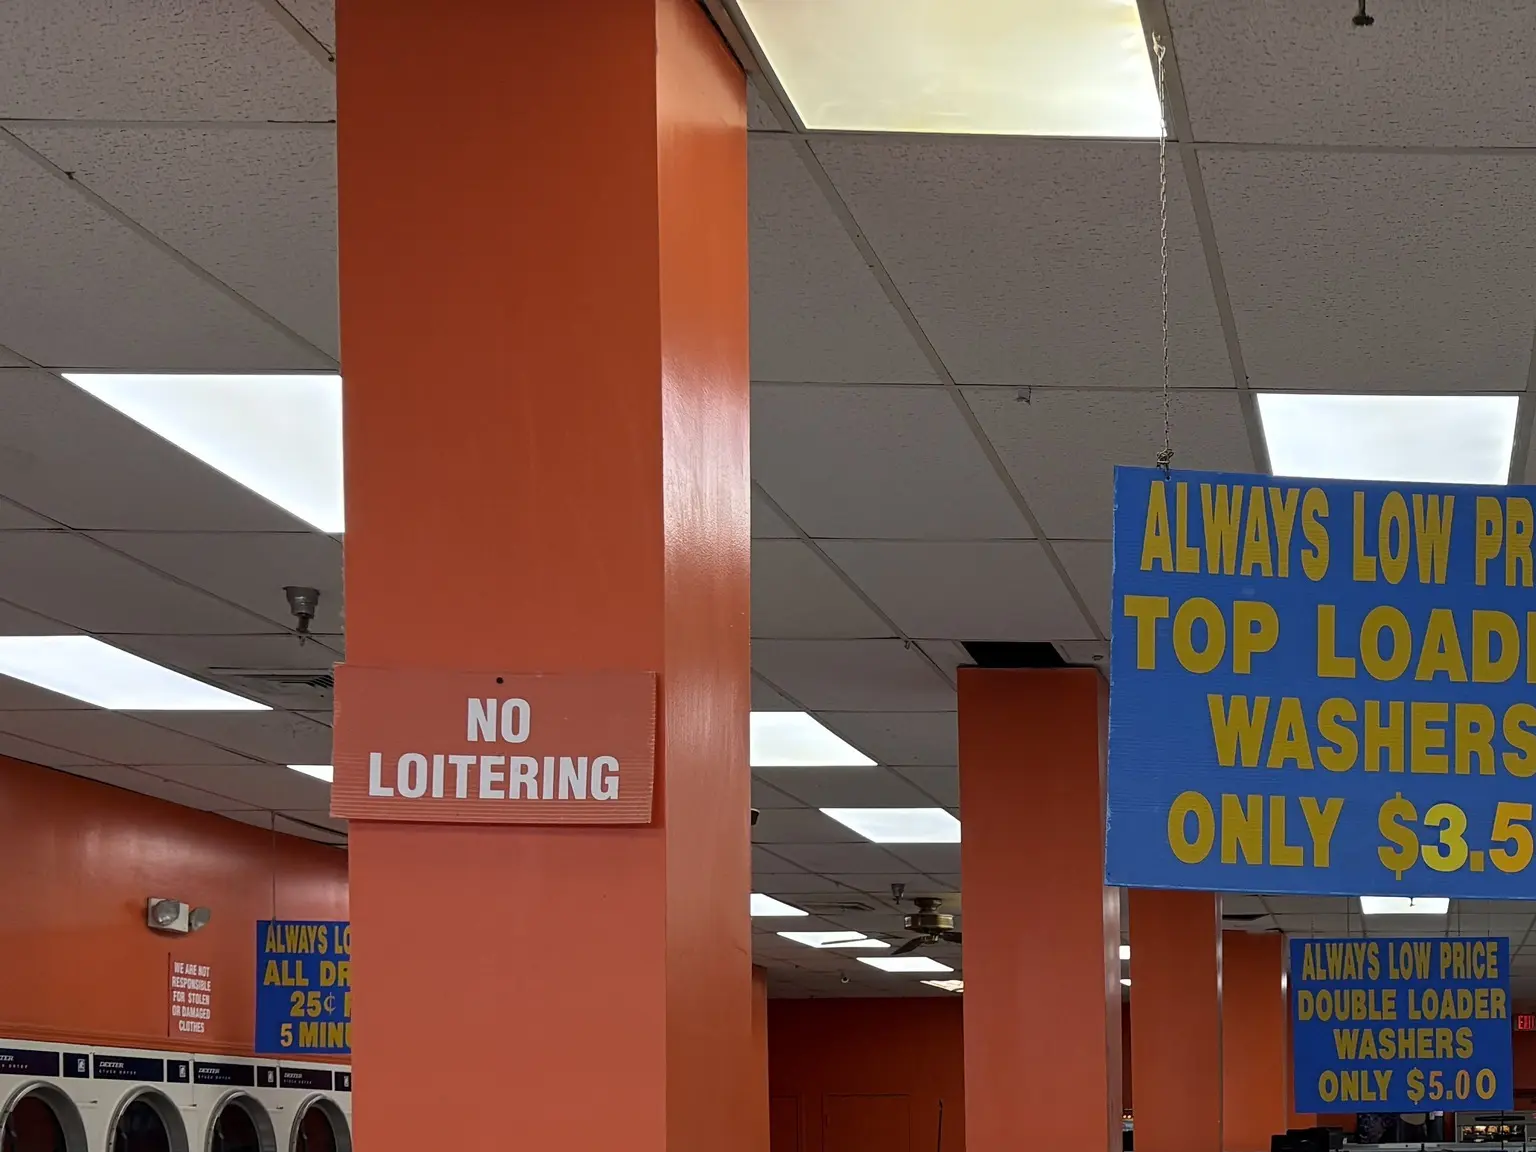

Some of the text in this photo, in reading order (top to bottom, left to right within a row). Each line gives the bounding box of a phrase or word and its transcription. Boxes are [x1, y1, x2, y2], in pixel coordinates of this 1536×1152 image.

[1140, 481, 1329, 582] ALWAYS
[1353, 491, 1454, 584] LOW
[1124, 595, 1279, 673] TOP
[466, 698, 531, 744] NO
[368, 752, 620, 801] LOITERING
[1167, 790, 1344, 867] ONLY
[265, 925, 350, 954] ALWAYS LO
[174, 962, 210, 977] WE ARE NOT
[264, 960, 309, 986] ALL
[1302, 942, 1498, 980] ALWAYS LOW PRICE
[172, 976, 211, 991] RESPONSIBLE
[173, 991, 210, 1005] FOR STOLEN
[172, 1005, 210, 1019] OR DAMAGED
[290, 991, 336, 1017] 25¢
[1298, 988, 1506, 1021] DOUBLE LOADER
[179, 1020, 204, 1032] CLOTHES
[281, 1023, 293, 1047] 5
[1334, 1027, 1473, 1060] WASHERS
[1318, 1067, 1496, 1105] ONLY $5.00
